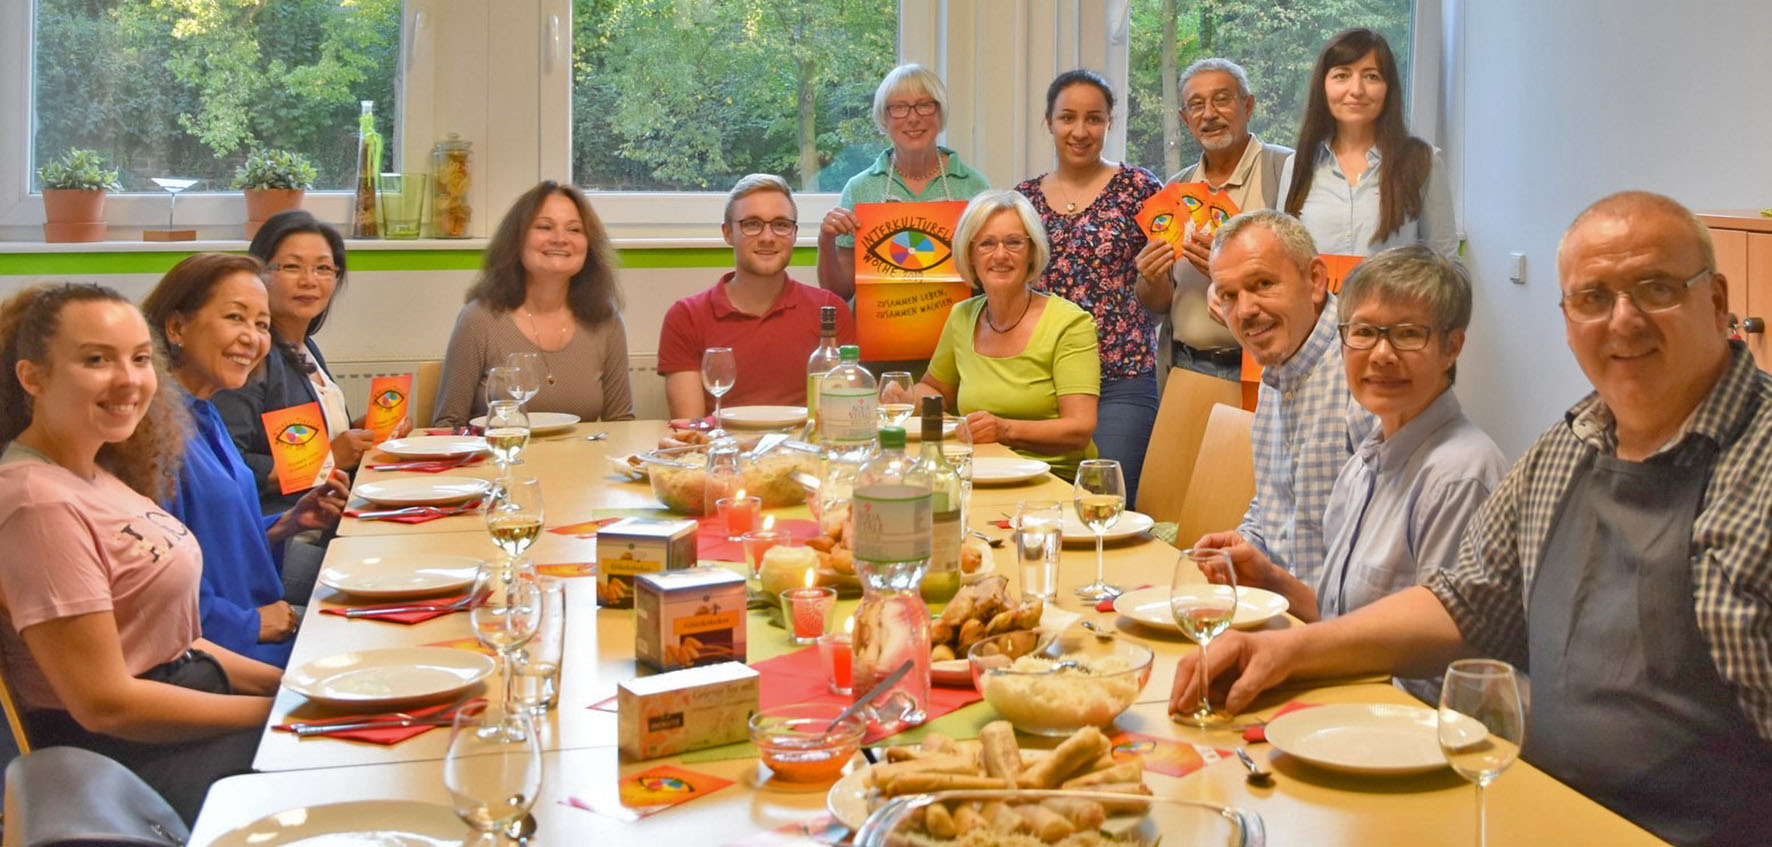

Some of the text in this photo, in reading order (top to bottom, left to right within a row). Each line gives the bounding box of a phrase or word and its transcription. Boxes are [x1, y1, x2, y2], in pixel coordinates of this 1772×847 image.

[863, 252, 897, 278] WOCHE
[875, 297, 953, 319] ZUSAMMEN WACHSEN
[876, 296, 918, 308] ZUSAMMEN
